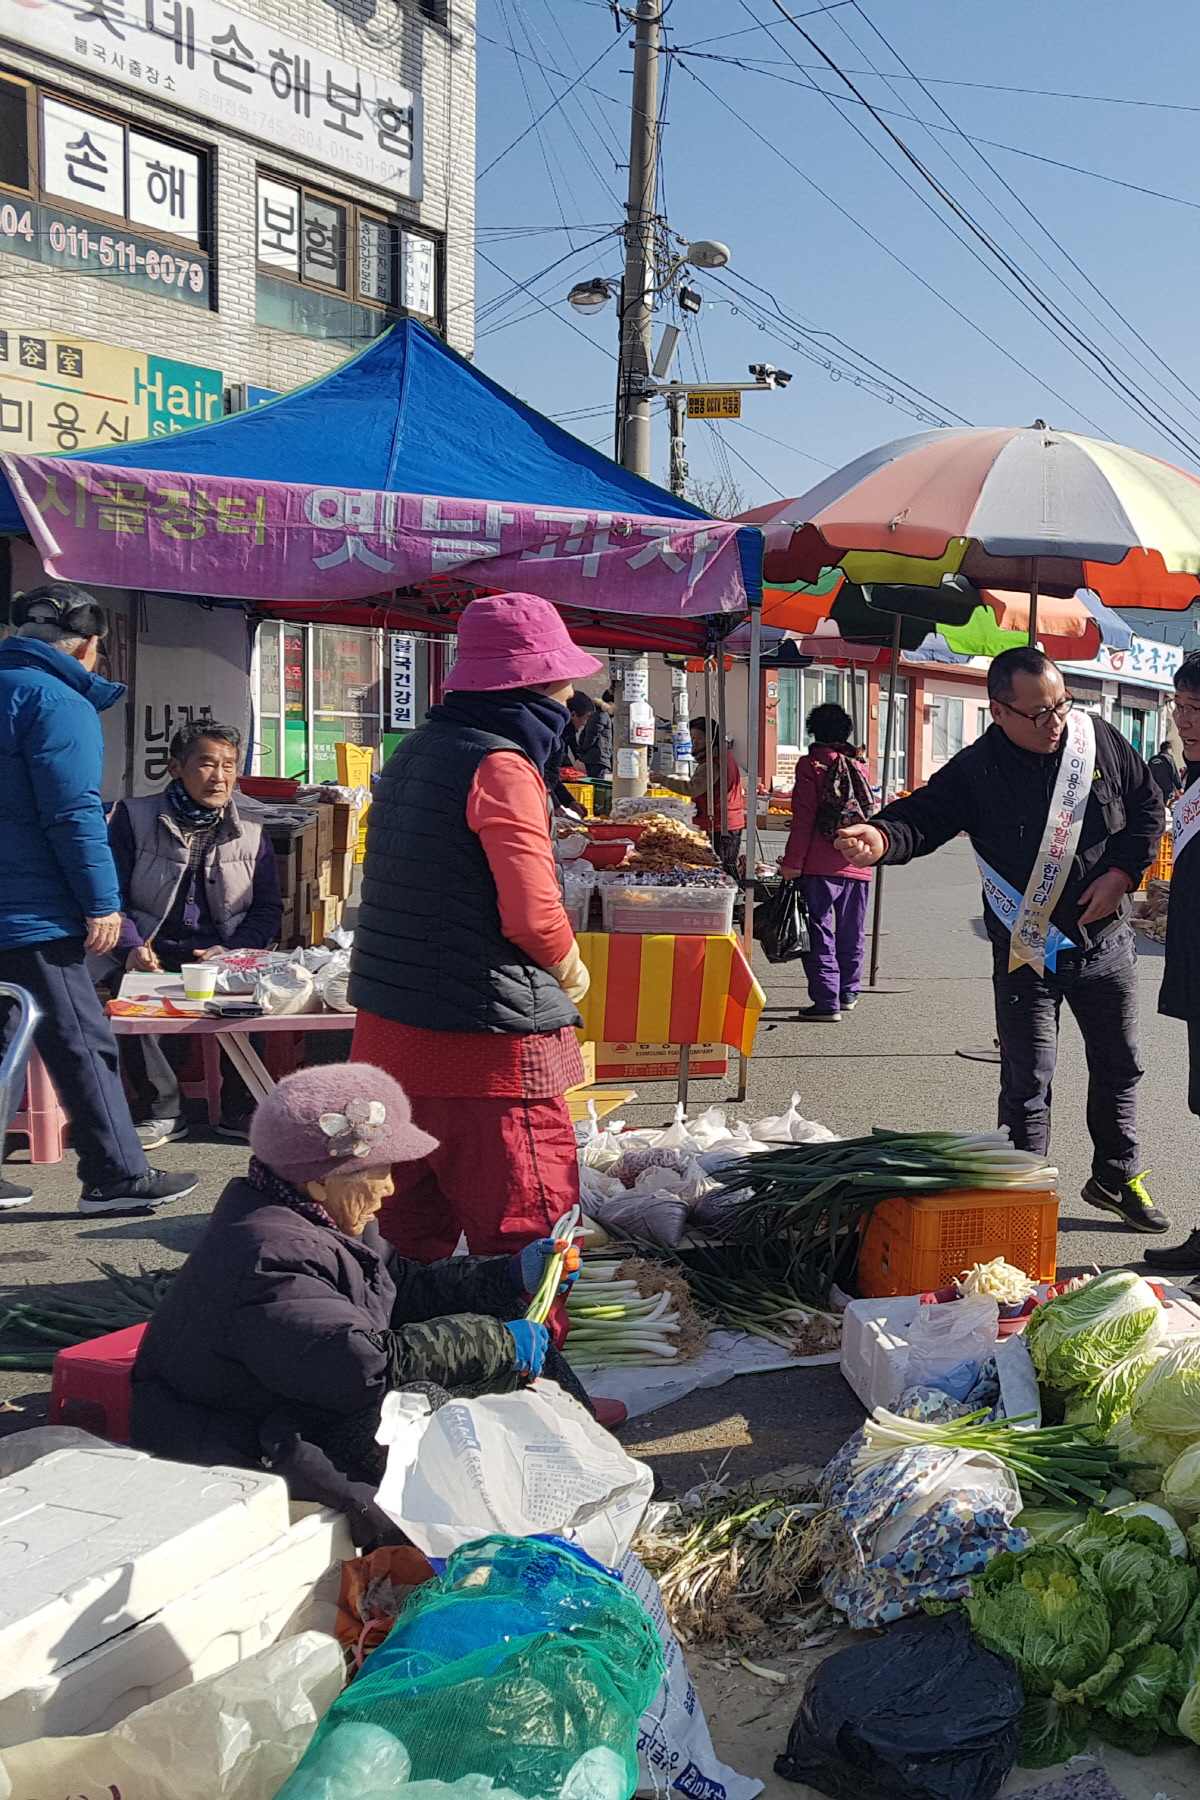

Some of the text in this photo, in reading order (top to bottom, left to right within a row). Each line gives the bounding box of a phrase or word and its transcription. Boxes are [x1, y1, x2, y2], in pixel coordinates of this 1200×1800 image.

[50, 221, 204, 292] 011-511-6079
[135, 367, 218, 421] Hair
[707, 396, 721, 412] CCTV
[37, 475, 267, 546] 시골장터
[393, 638, 412, 723] 불국건강원
[1128, 643, 1178, 678] 칼국수
[1046, 811, 1074, 861] 생활화
[1031, 863, 1060, 906] 합시다
[689, 1048, 714, 1056] OMPANY
